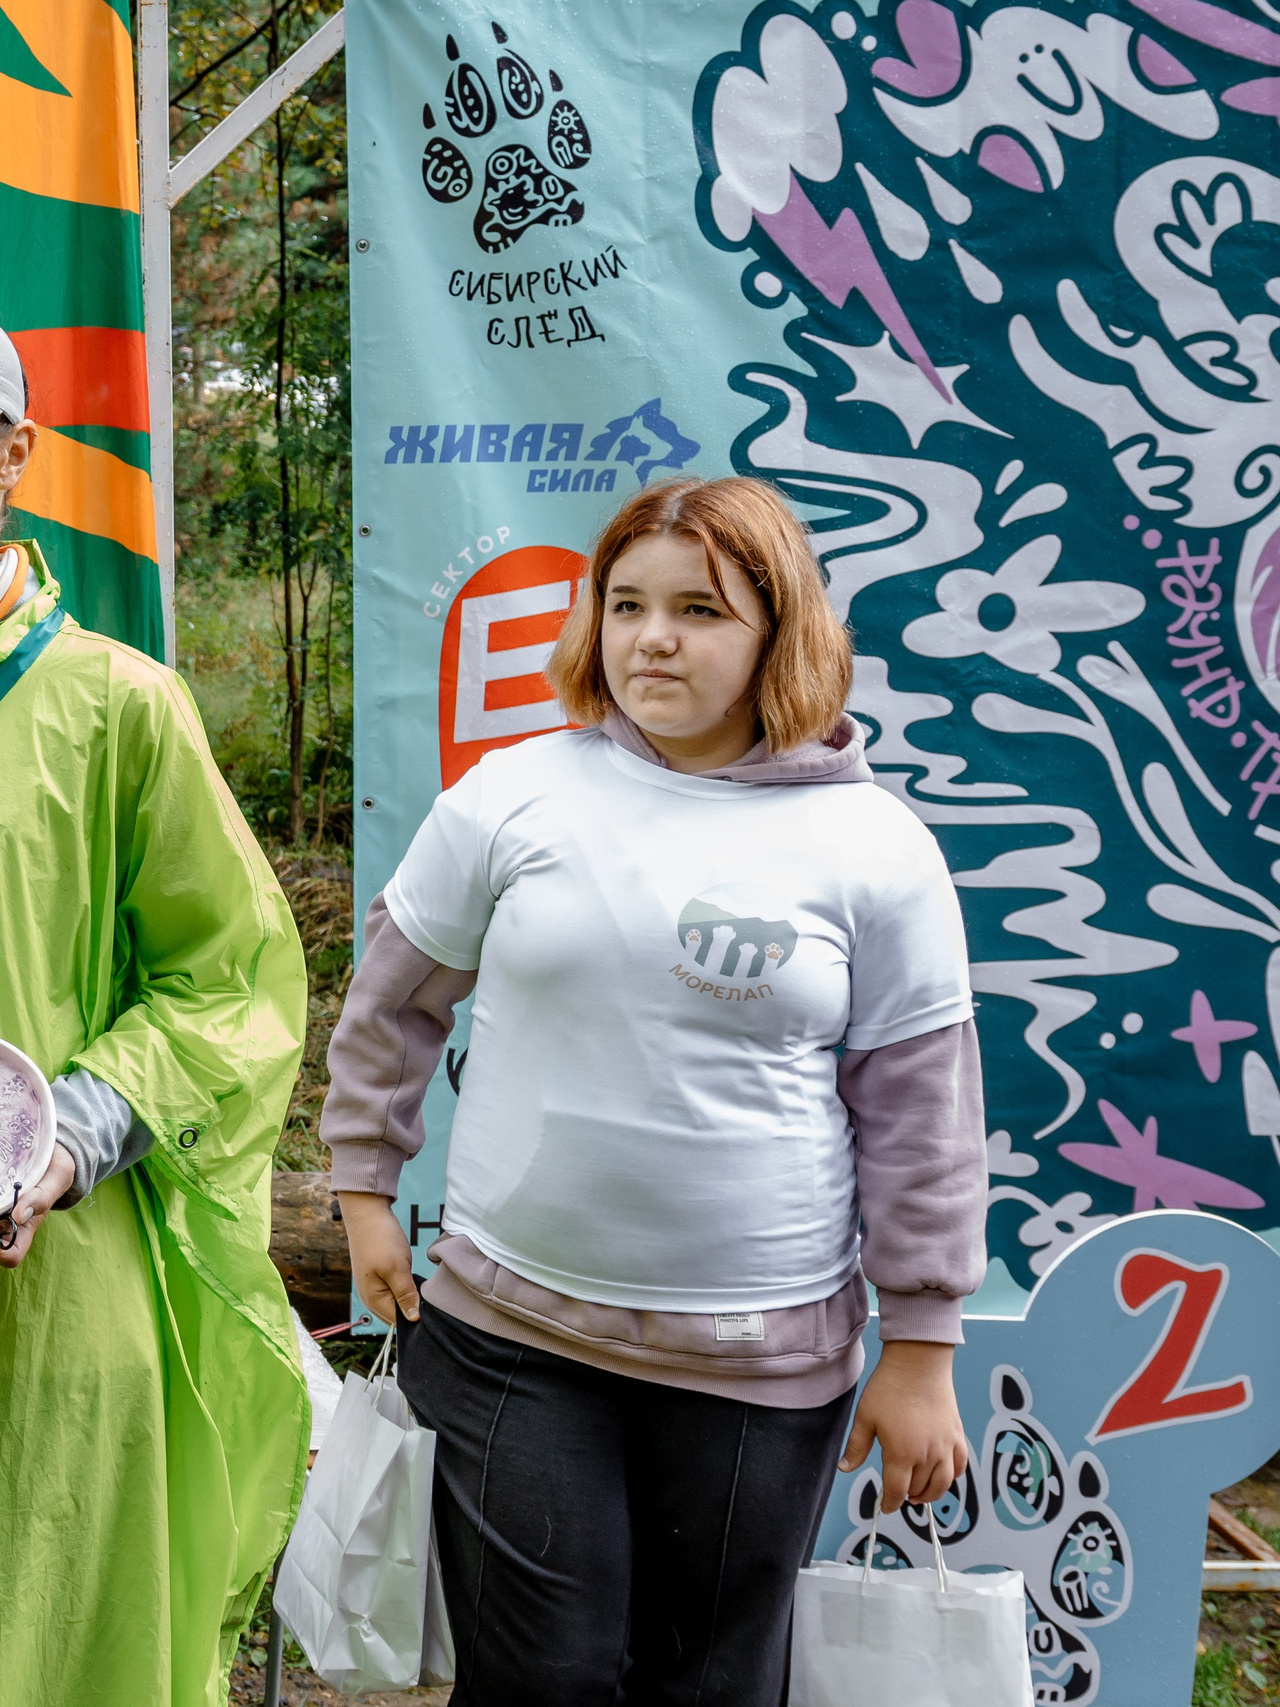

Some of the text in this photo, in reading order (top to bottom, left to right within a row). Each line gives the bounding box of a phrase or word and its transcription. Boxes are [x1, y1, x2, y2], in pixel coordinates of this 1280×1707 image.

[448, 245, 628, 304] СИБИРСКИЙ
[384, 423, 585, 465] ЖИВАЯ
[526, 468, 618, 493] СИЛА
[423, 525, 512, 618] СЕКТОР
[669, 963, 774, 1002] МОРЕЛАП
[1087, 1248, 1252, 1444] 2
